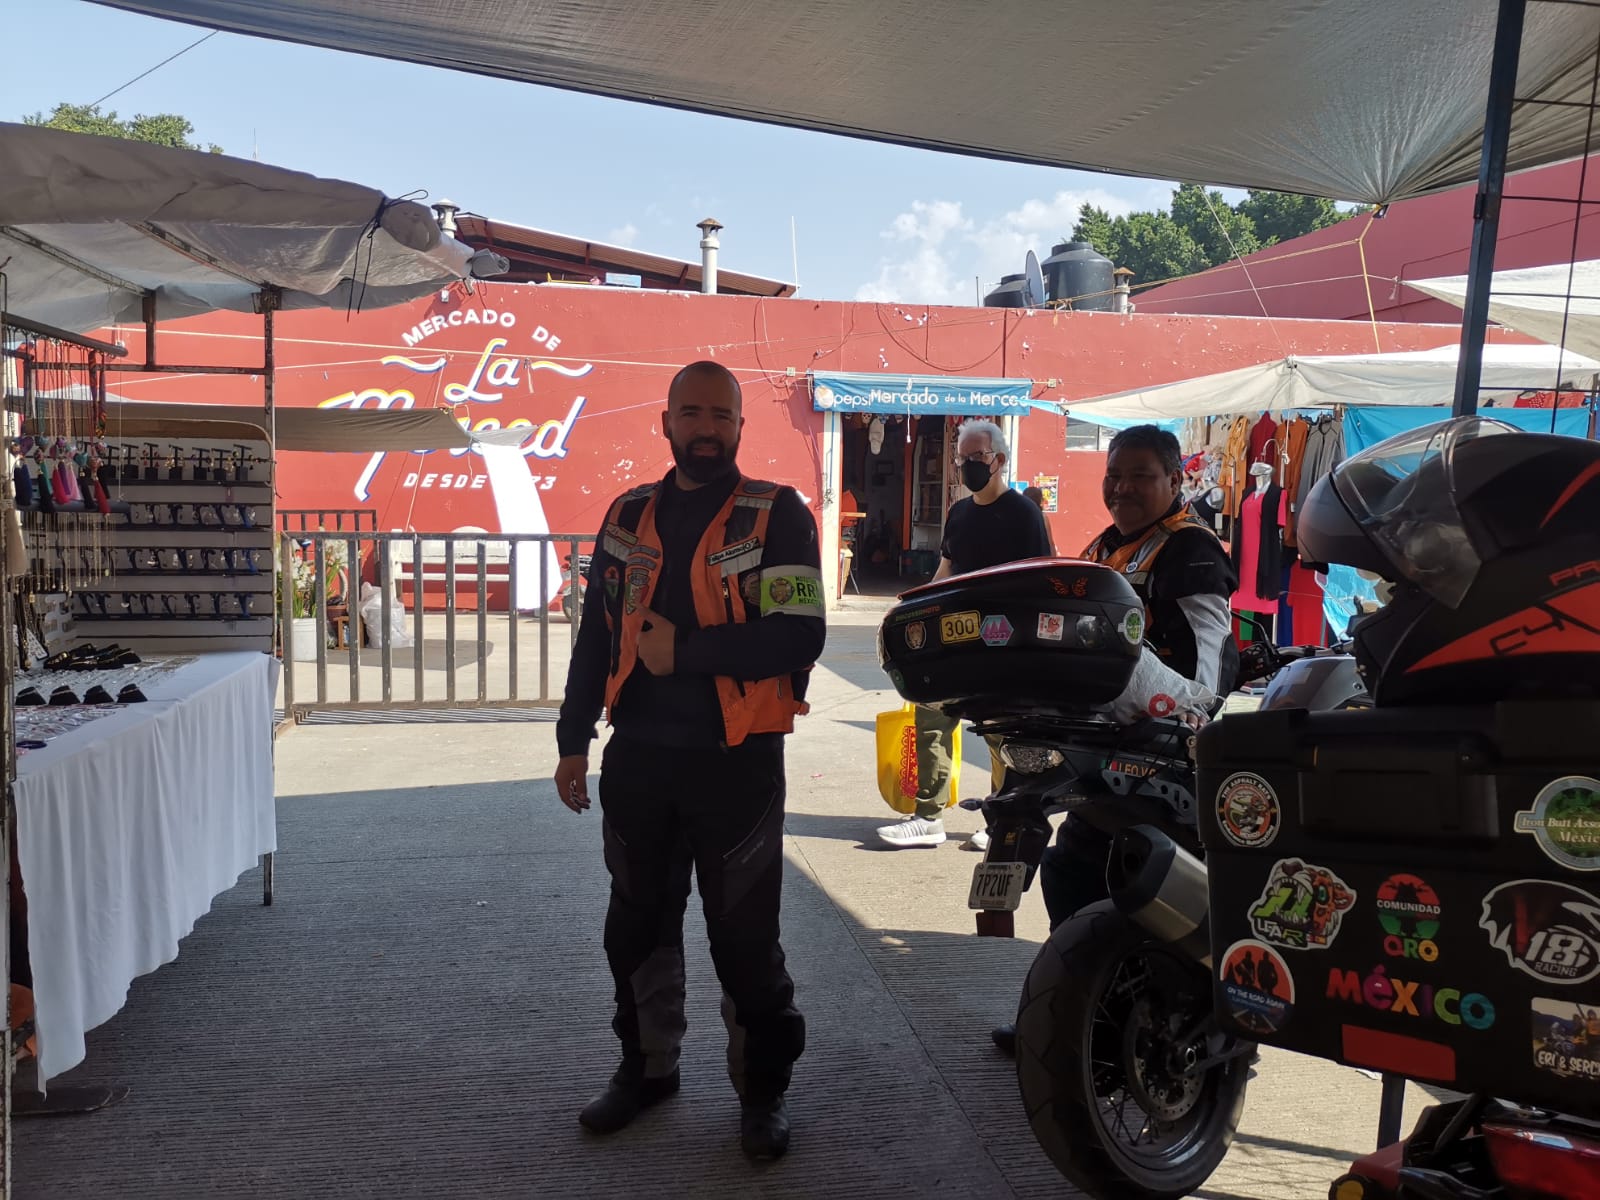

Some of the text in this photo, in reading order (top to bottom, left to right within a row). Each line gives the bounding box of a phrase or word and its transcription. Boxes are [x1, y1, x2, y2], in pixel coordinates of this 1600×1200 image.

[401, 309, 561, 351] MERCADO DE
[444, 338, 521, 402] La
[871, 387, 938, 405] Mercado
[970, 390, 1030, 407] Merced
[403, 473, 488, 489] DESDE
[945, 619, 975, 637] 300
[1376, 899, 1441, 915] COMUNIDAD
[1383, 935, 1440, 962] QRO
[1534, 961, 1578, 977] RACING
